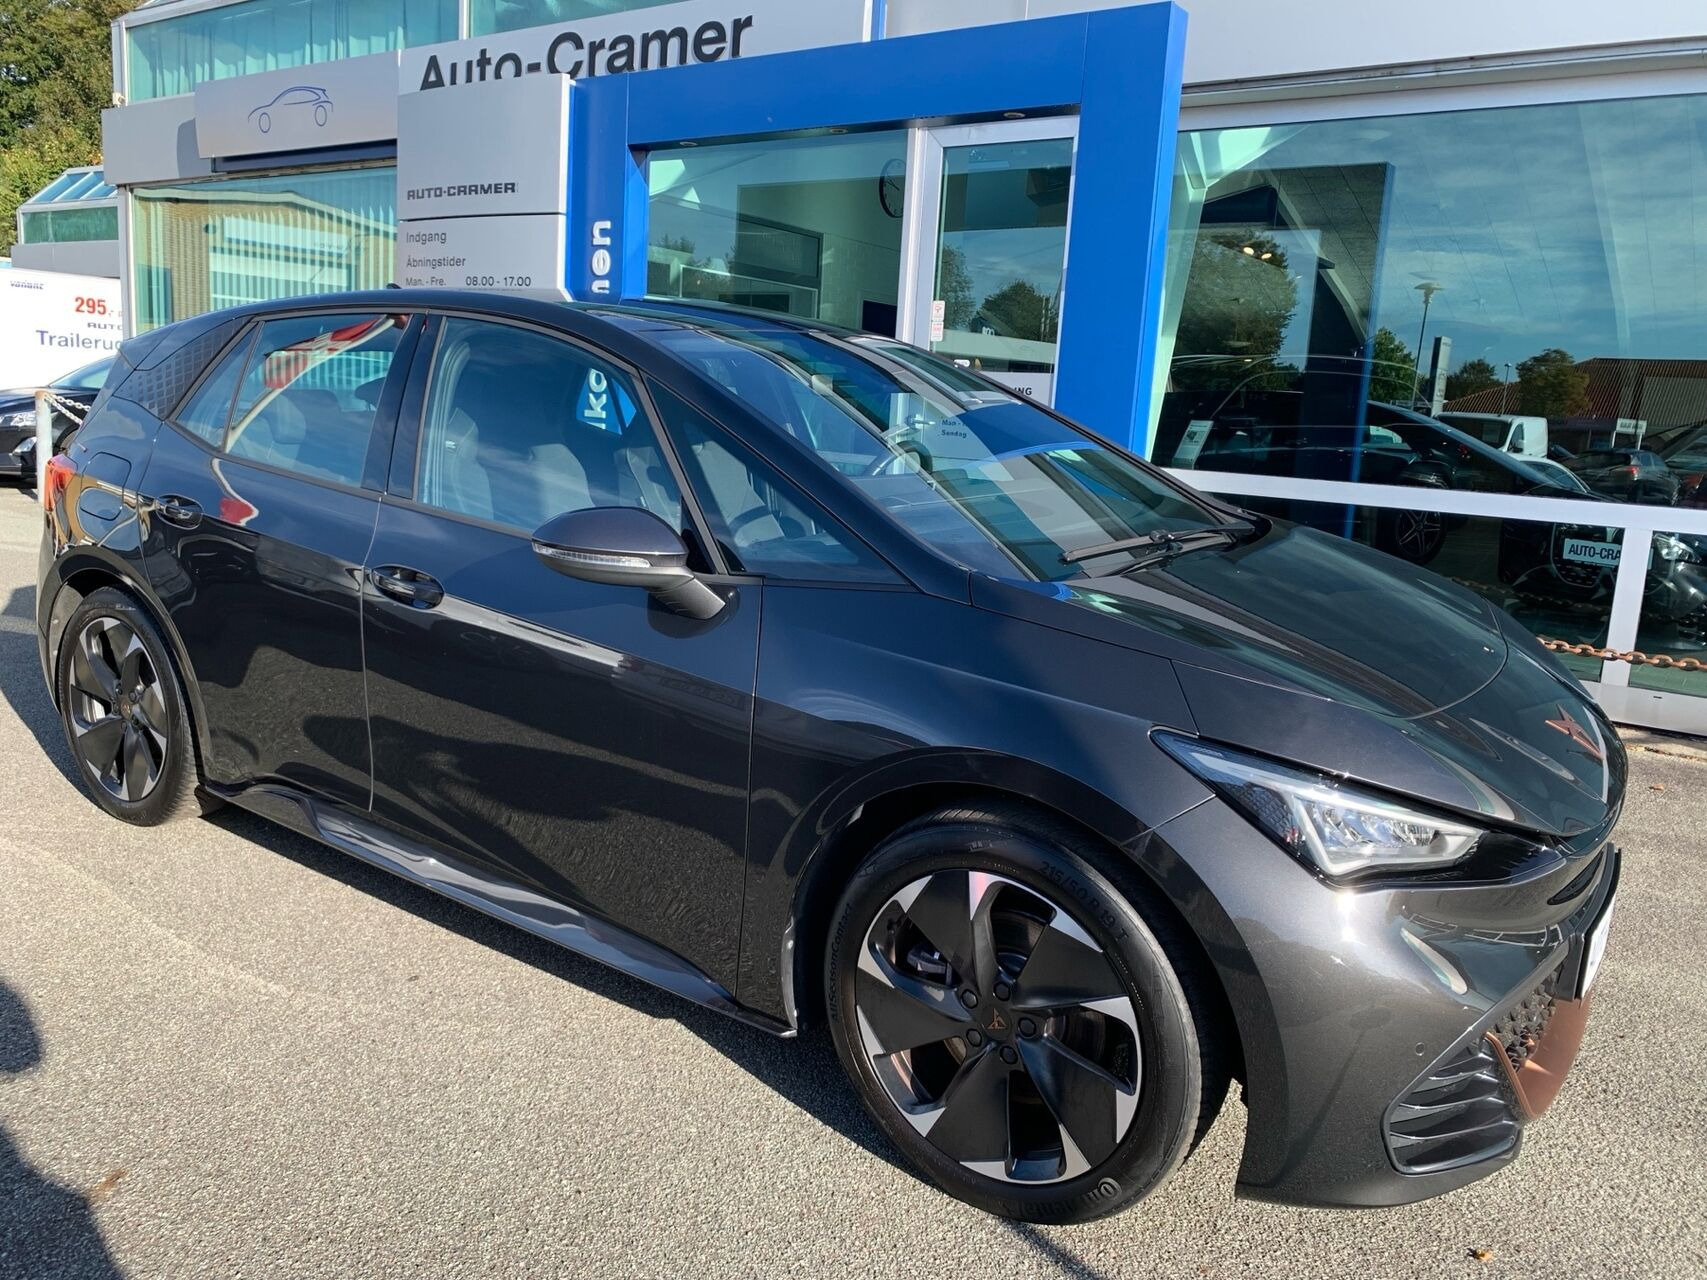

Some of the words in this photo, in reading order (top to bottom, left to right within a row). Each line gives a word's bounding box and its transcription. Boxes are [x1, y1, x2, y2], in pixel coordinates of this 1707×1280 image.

[420, 15, 753, 91] Auto-Cramer
[406, 232, 447, 245] Indgang
[406, 255, 466, 269] Åbningstider
[465, 276, 495, 287] 08.00
[503, 276, 531, 287] 17.00
